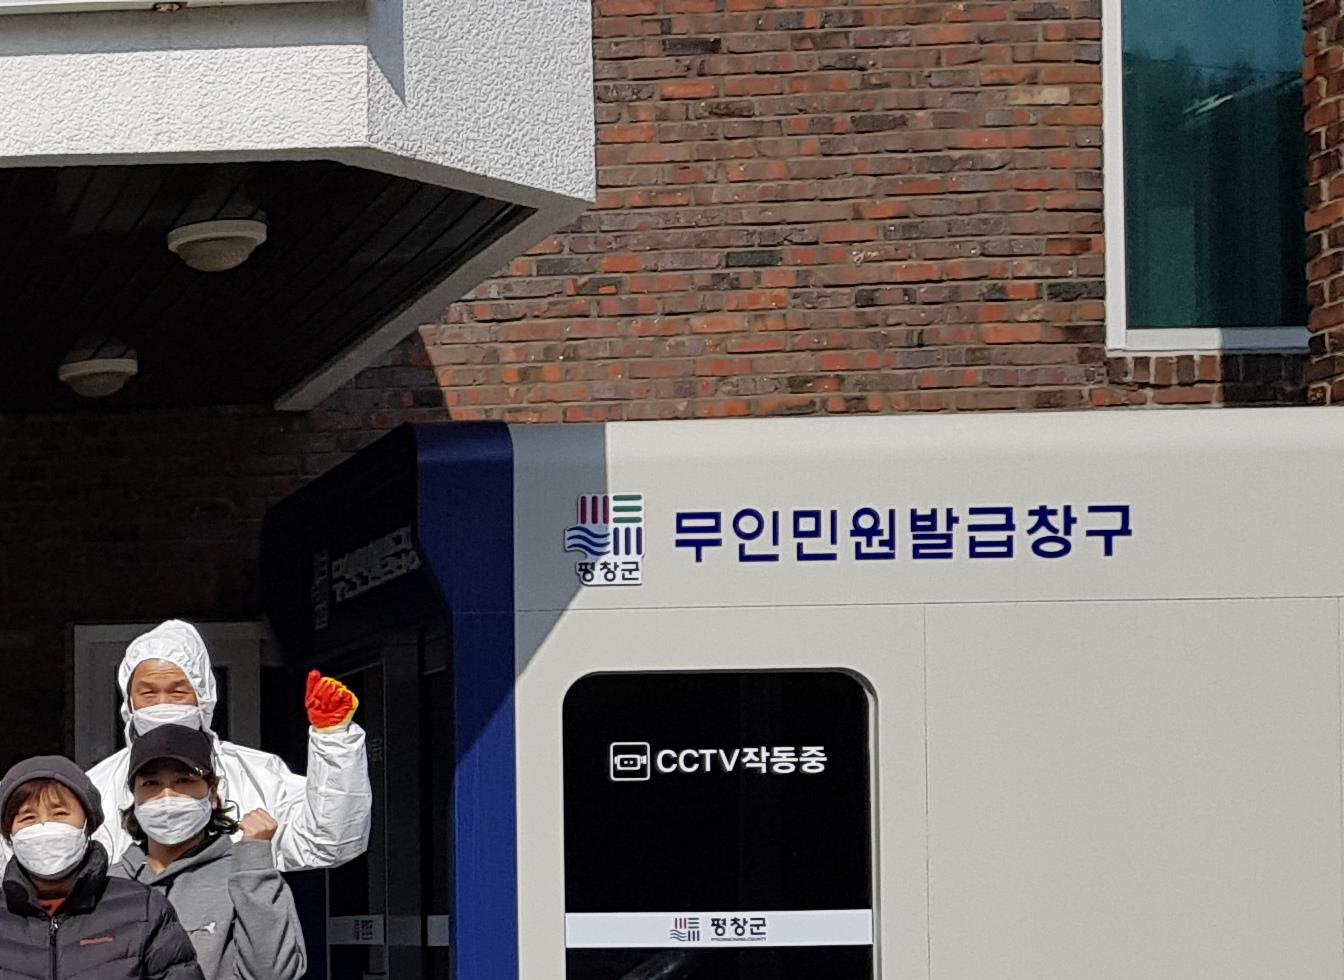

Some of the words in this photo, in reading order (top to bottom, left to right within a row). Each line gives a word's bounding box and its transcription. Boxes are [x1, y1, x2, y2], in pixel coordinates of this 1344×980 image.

[674, 504, 1133, 563] 무인민원발급창구
[577, 561, 640, 583] 평창군
[656, 746, 828, 774] CCTV작동중
[710, 917, 767, 937] 평창군
